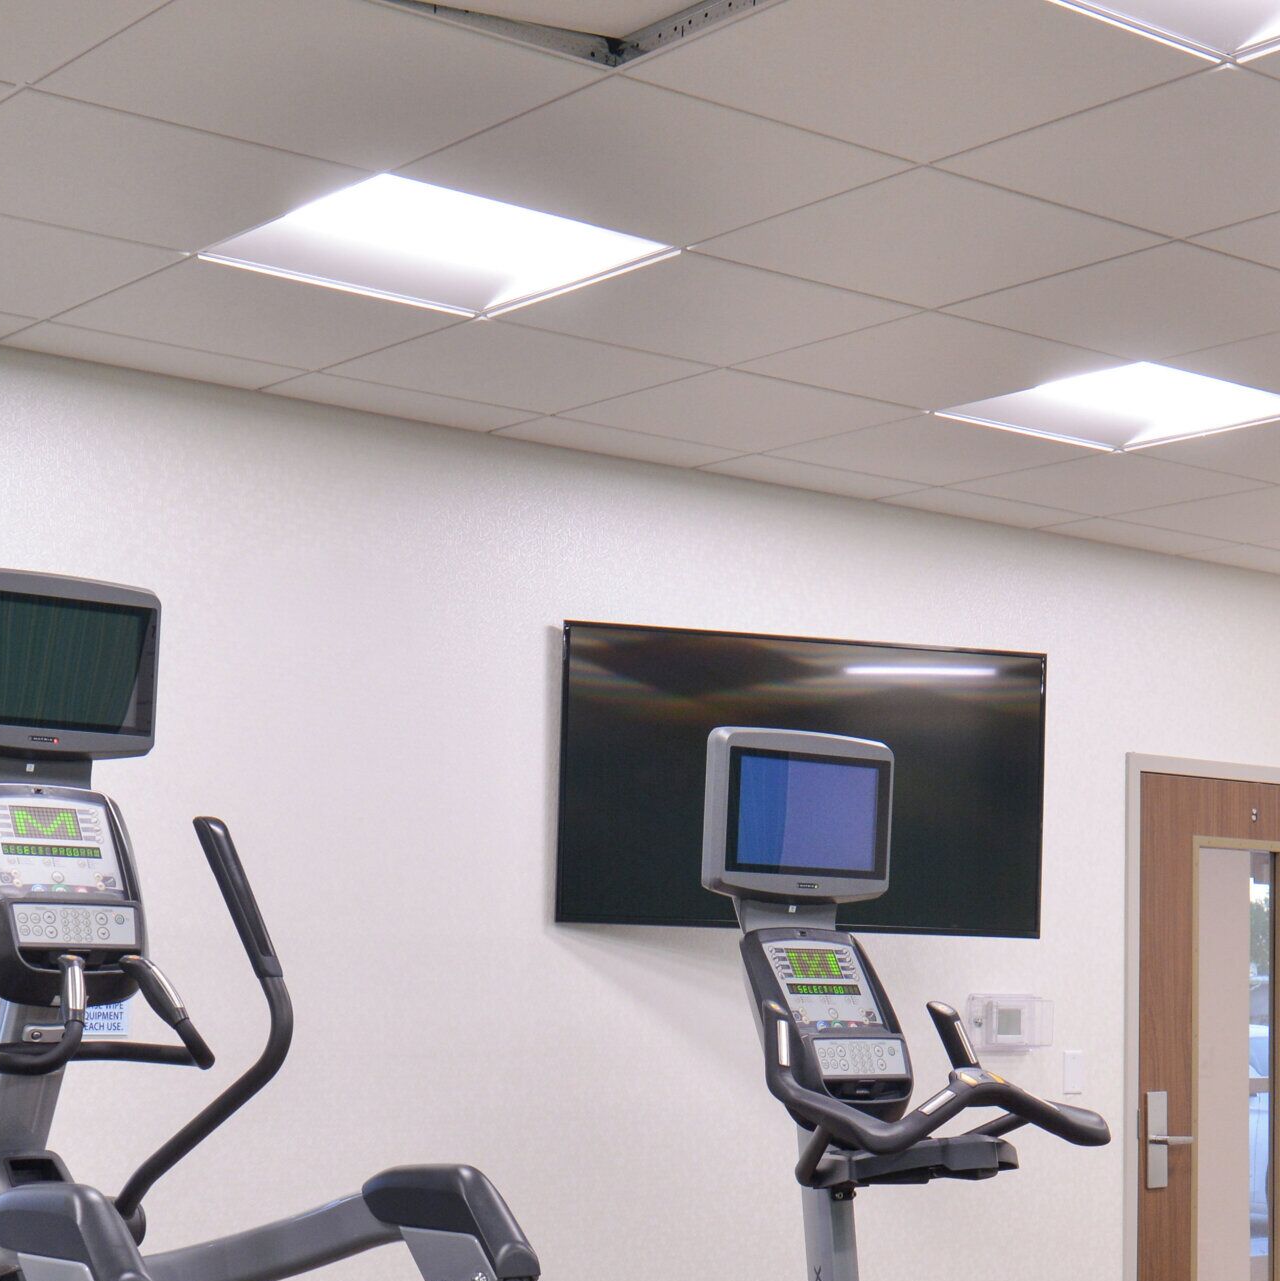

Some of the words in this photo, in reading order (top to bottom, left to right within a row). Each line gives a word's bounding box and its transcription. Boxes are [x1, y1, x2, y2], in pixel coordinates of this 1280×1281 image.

[797, 985, 829, 994] SELECT
[85, 1011, 124, 1020] QUIPMENT
[107, 1023, 123, 1031] USE.
